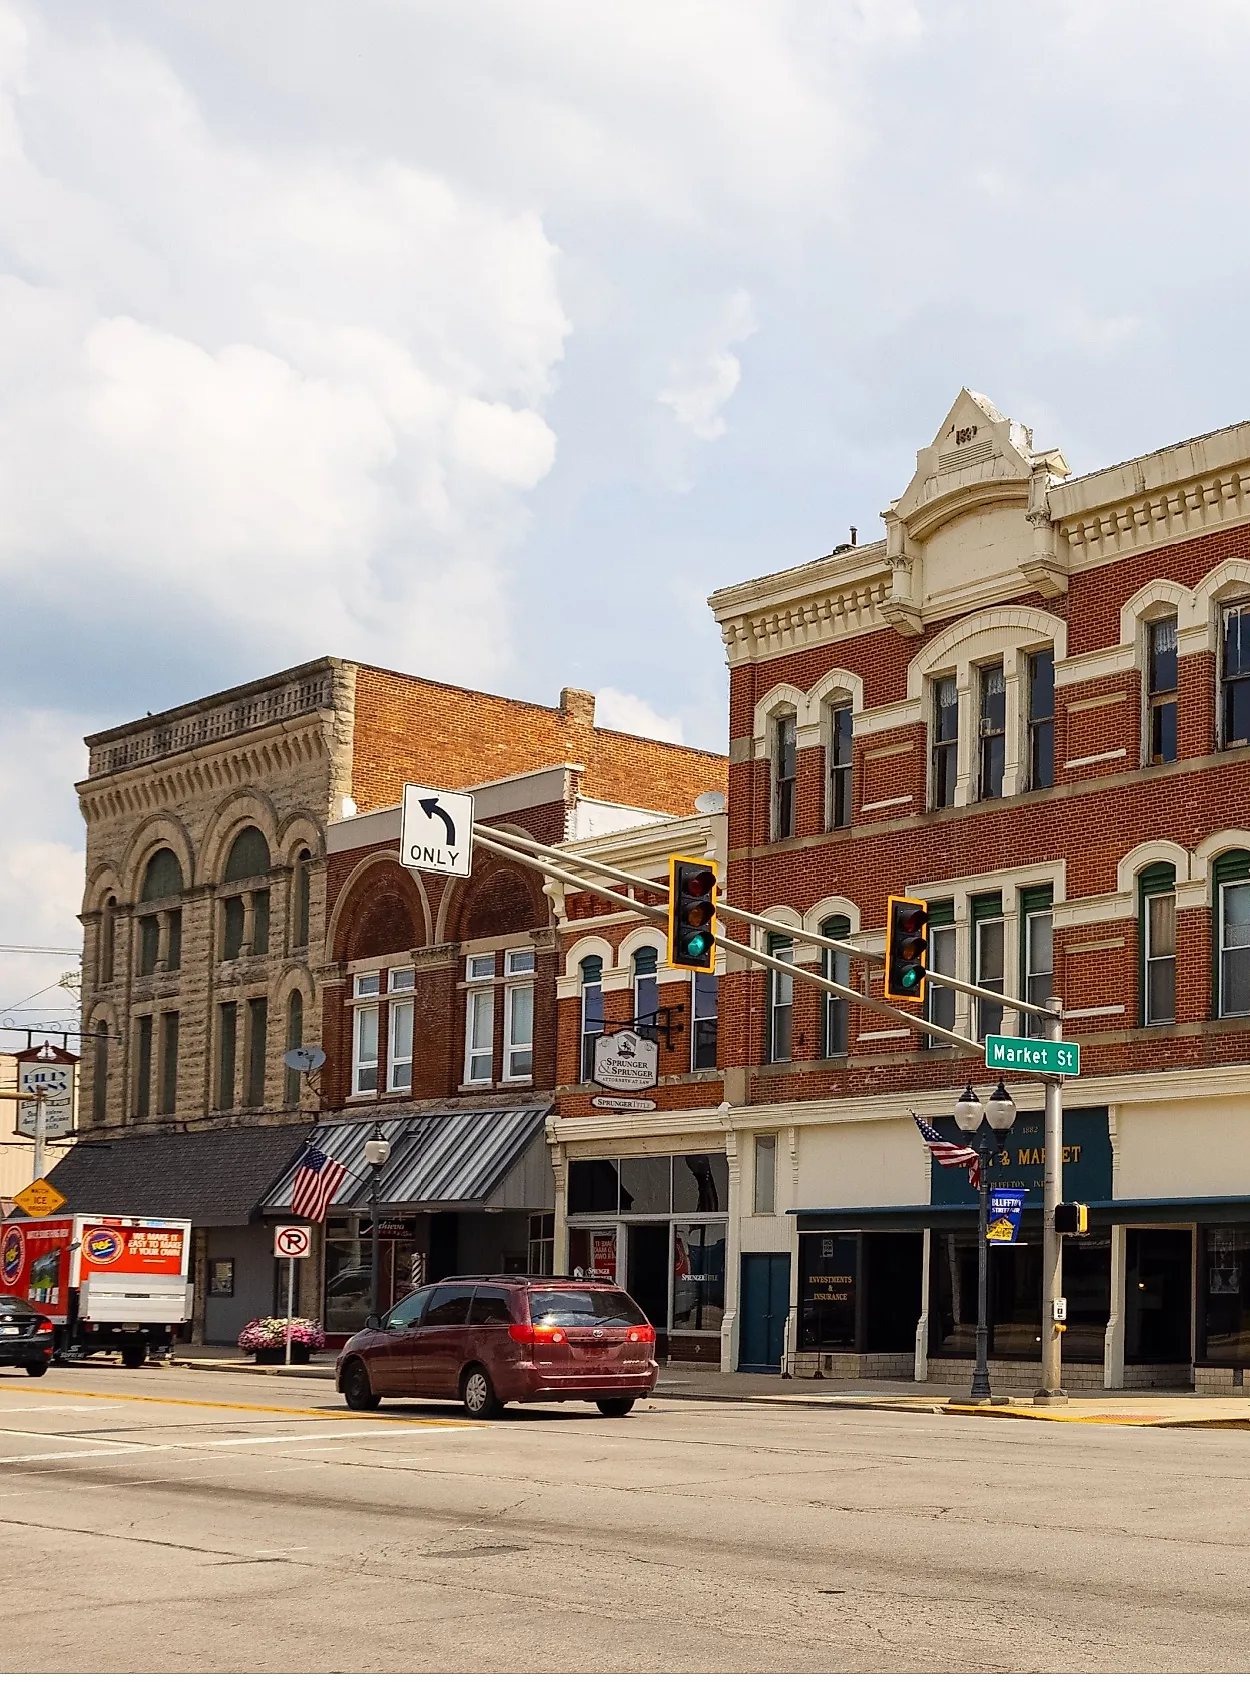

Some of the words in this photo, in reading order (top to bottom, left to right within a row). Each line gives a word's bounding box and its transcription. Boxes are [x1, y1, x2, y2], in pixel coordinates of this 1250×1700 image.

[411, 844, 460, 867] ONLY
[993, 1043, 1048, 1065] Market
[1057, 1049, 1073, 1067] St
[598, 1060, 610, 1074] &
[611, 1066, 653, 1078] SPRUNGER
[606, 1057, 648, 1069] SPRUNGER
[1018, 1145, 1081, 1166] MAET
[34, 1196, 47, 1204] ICE
[808, 1275, 853, 1284] INVESTMENTS
[813, 1293, 848, 1301] INSURANCE
